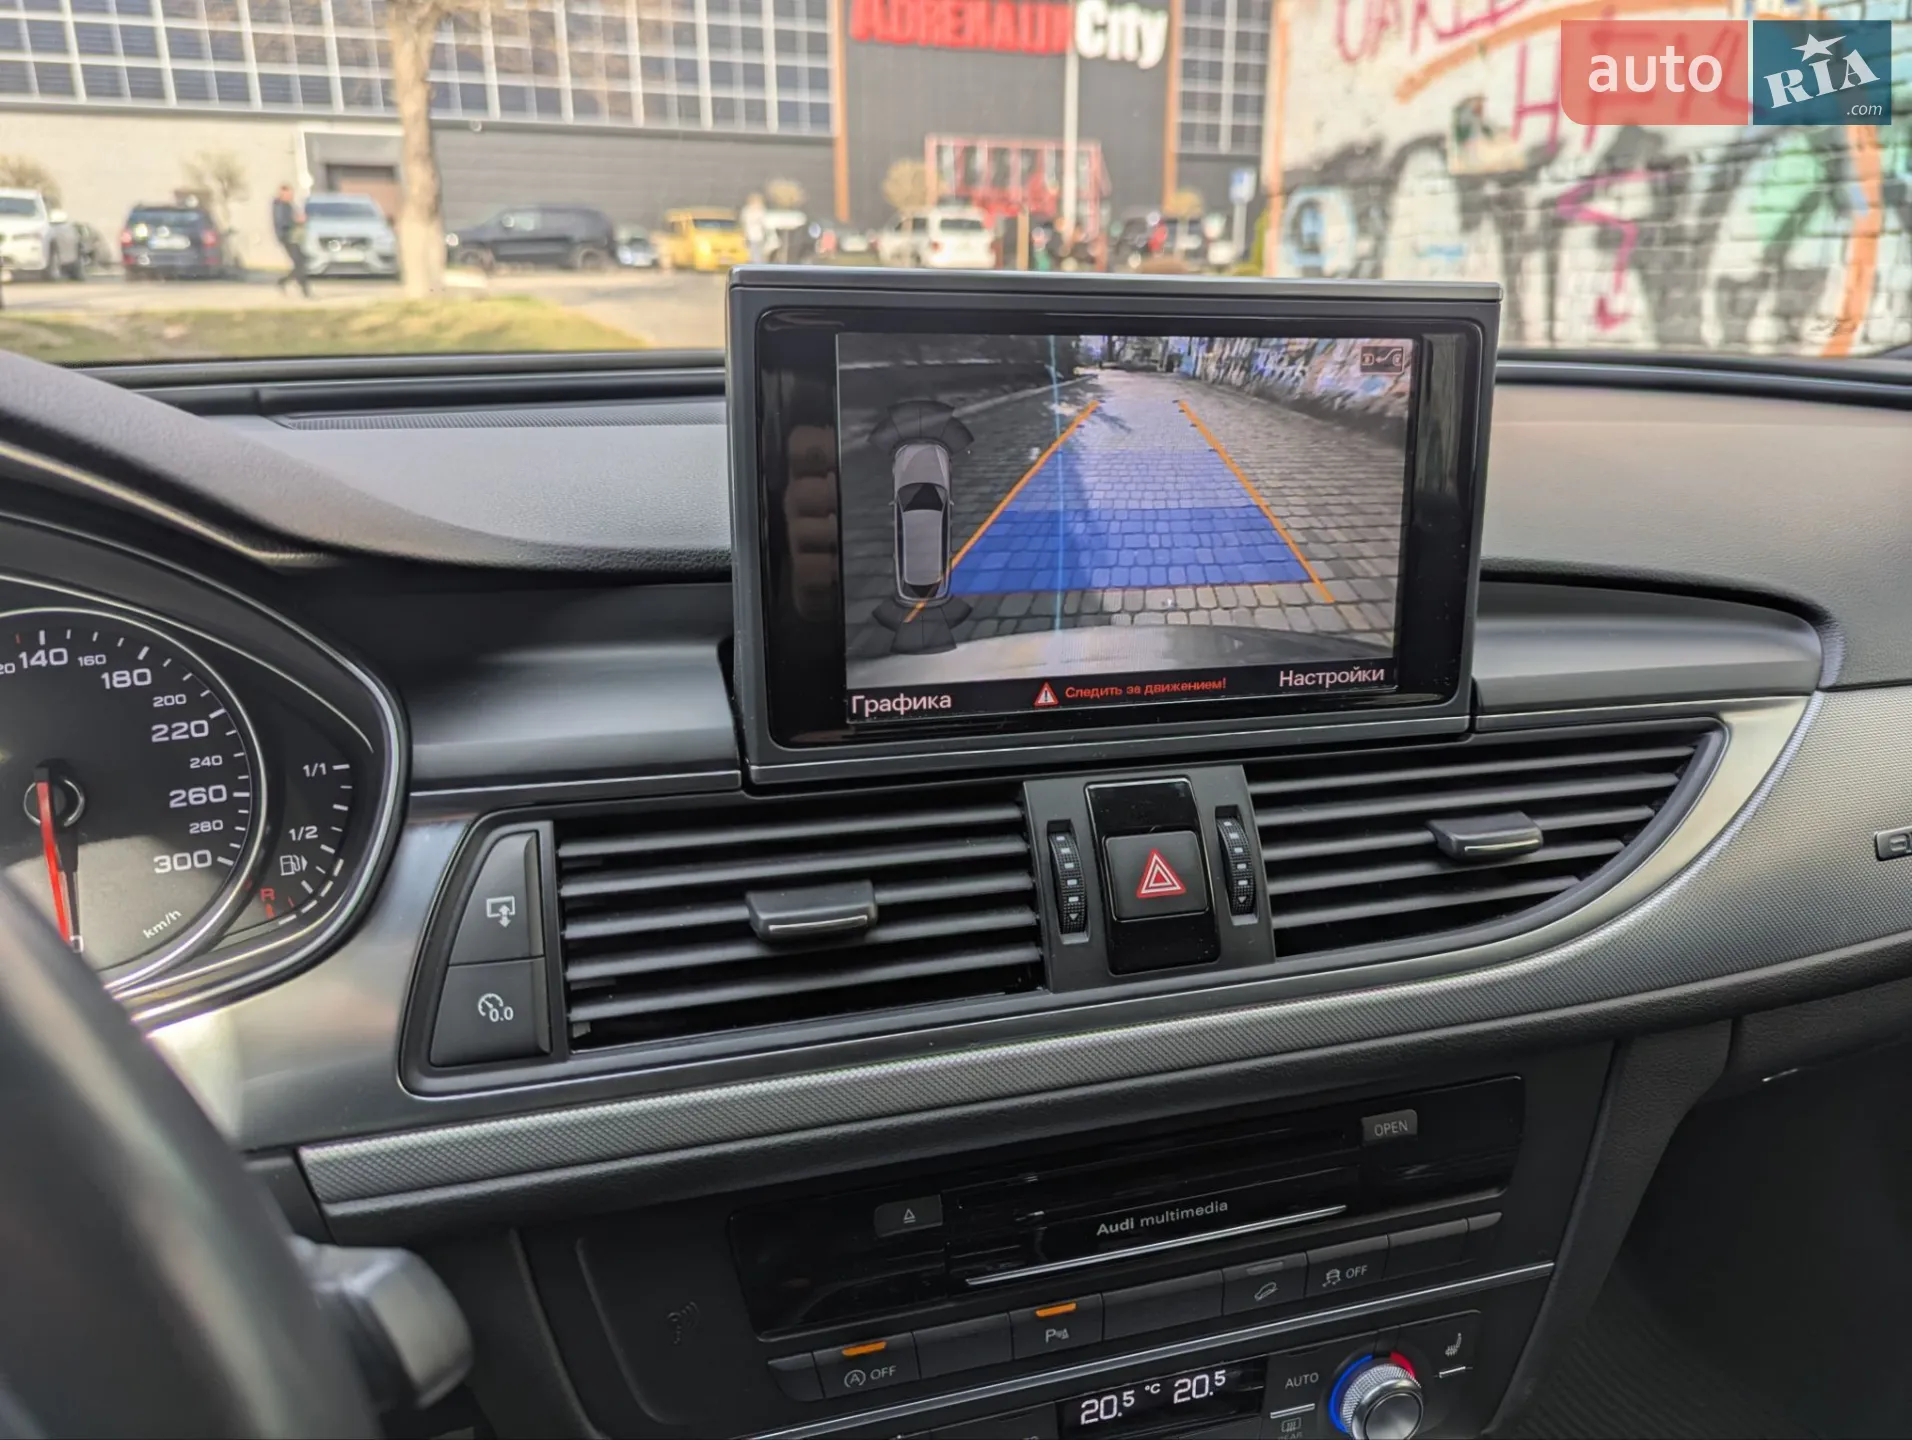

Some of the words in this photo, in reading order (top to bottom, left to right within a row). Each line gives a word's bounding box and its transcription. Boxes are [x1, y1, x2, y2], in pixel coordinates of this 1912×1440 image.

[1074, 0, 1168, 69] City
[19, 648, 68, 669] 140
[78, 654, 107, 667] 160
[101, 668, 152, 689] 180
[1065, 686, 1123, 699] Следить
[1126, 685, 1141, 695] за
[1144, 677, 1227, 696] движением!
[1279, 666, 1385, 689] Настройки
[153, 694, 187, 707] 200
[852, 692, 952, 717] Графика
[151, 720, 209, 742] 220
[190, 755, 223, 769] 240
[302, 763, 327, 777] 1/1
[169, 784, 227, 808] 260
[189, 820, 224, 834] 280
[289, 825, 319, 841] 1/2
[153, 850, 213, 874] 300
[143, 910, 182, 939] km/h
[489, 1006, 514, 1022] 0.0
[1374, 1120, 1408, 1137] OPEN
[1096, 1217, 1135, 1236] Audi
[1140, 1200, 1228, 1227] multimedia
[1345, 1265, 1368, 1279] OFF
[870, 1365, 897, 1380] OFF
[1284, 1372, 1319, 1390] AUTO
[1081, 1390, 1136, 1425] 20.5
[1144, 1383, 1161, 1394] °C
[1173, 1370, 1227, 1404] 20.5
